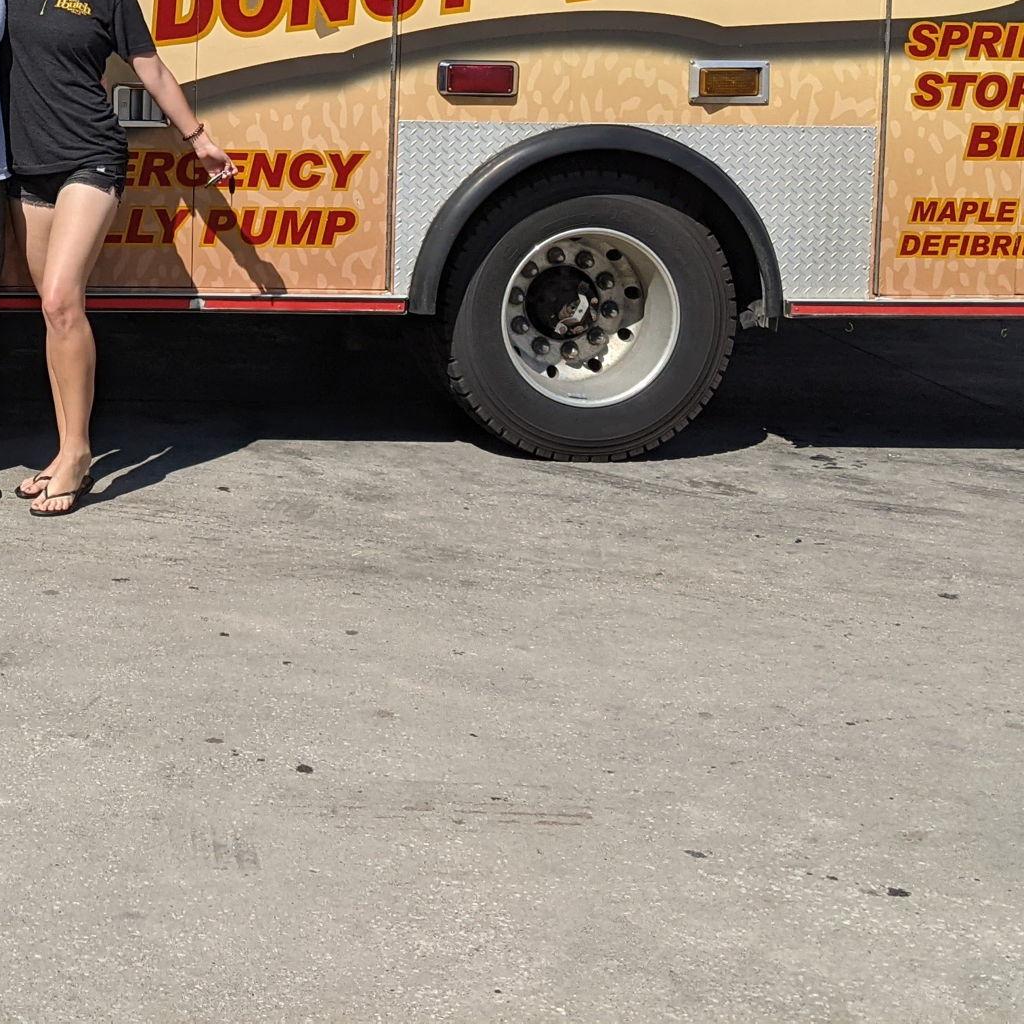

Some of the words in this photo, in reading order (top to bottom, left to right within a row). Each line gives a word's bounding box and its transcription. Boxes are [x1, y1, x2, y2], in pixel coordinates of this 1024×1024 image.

[905, 21, 1024, 61] SPRI
[963, 122, 1024, 161] BI
[125, 149, 370, 191] RGENCY
[198, 207, 359, 248] PUMP
[908, 198, 1019, 225] MAPLE
[896, 231, 1024, 259] DEFIBRI
